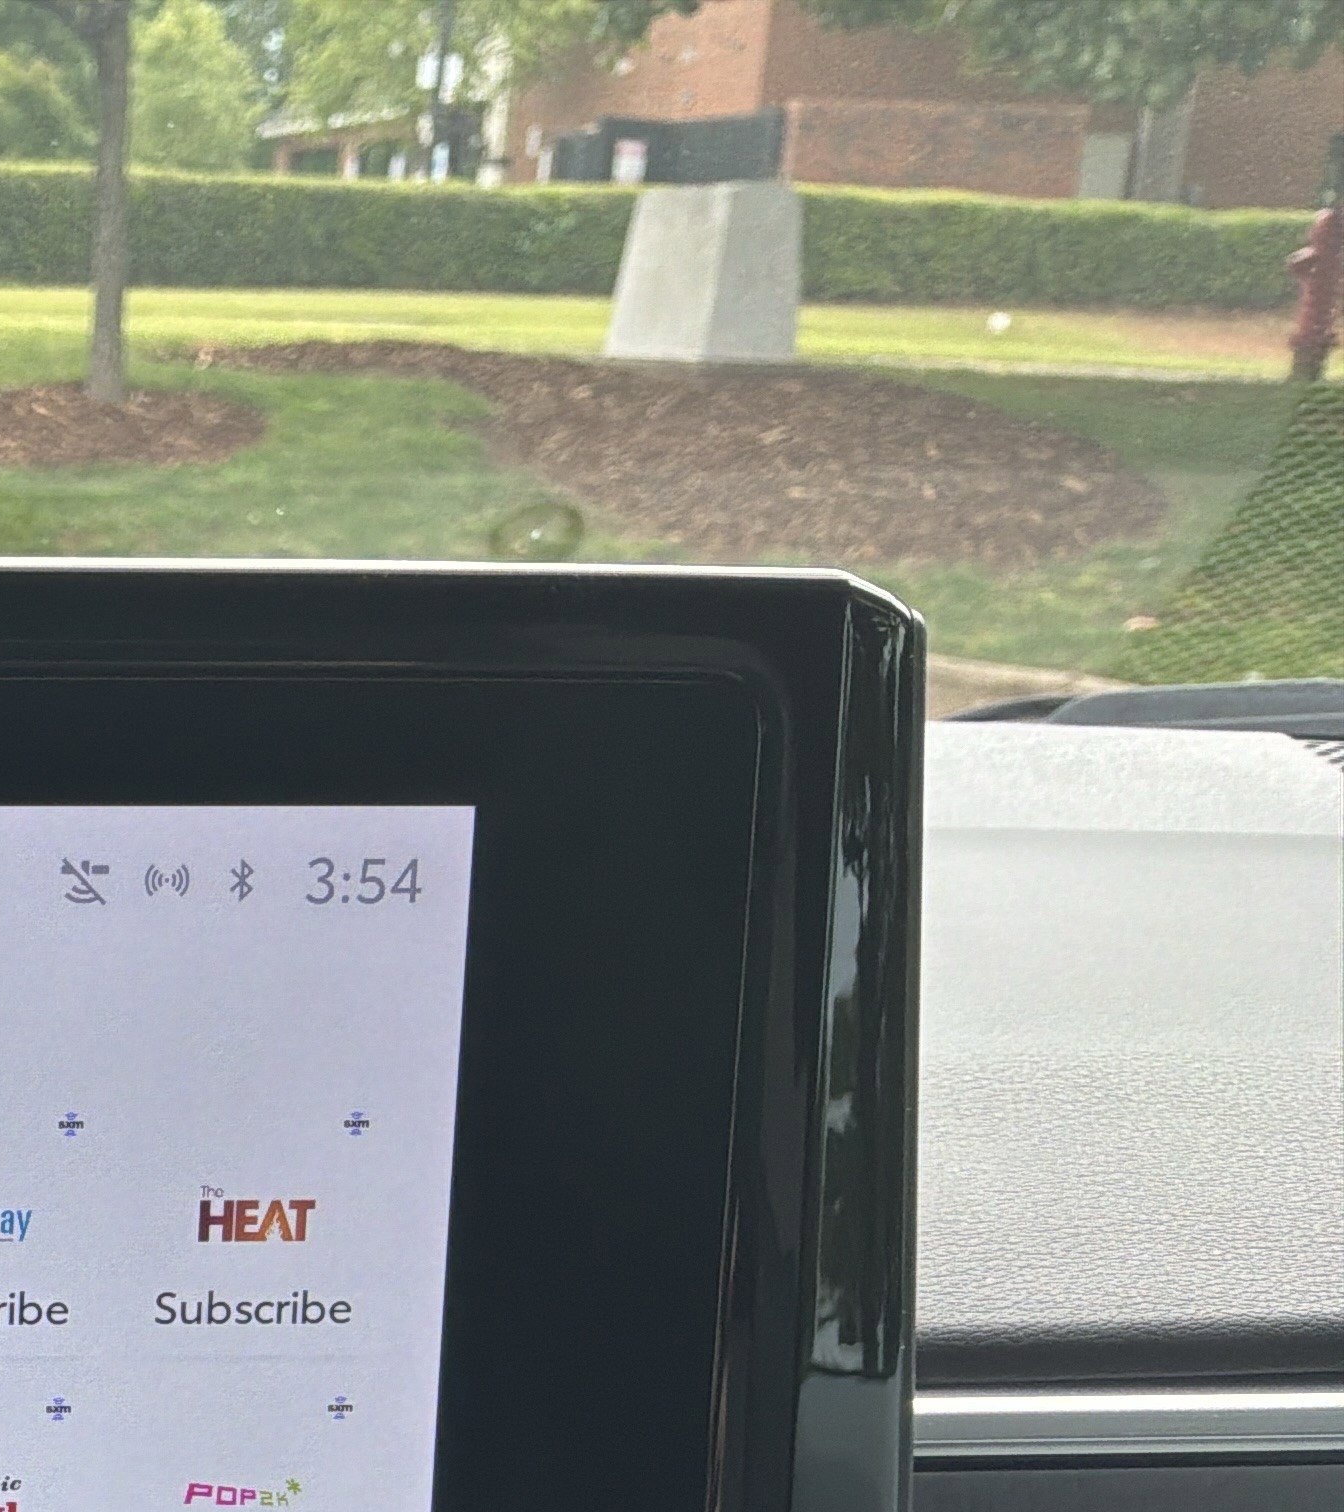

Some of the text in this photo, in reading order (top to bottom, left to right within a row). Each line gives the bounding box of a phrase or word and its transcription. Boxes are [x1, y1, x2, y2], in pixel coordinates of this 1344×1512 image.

[305, 857, 423, 904] 3:54
[197, 1199, 316, 1242] HEAT
[154, 1289, 352, 1325] Subscribe
